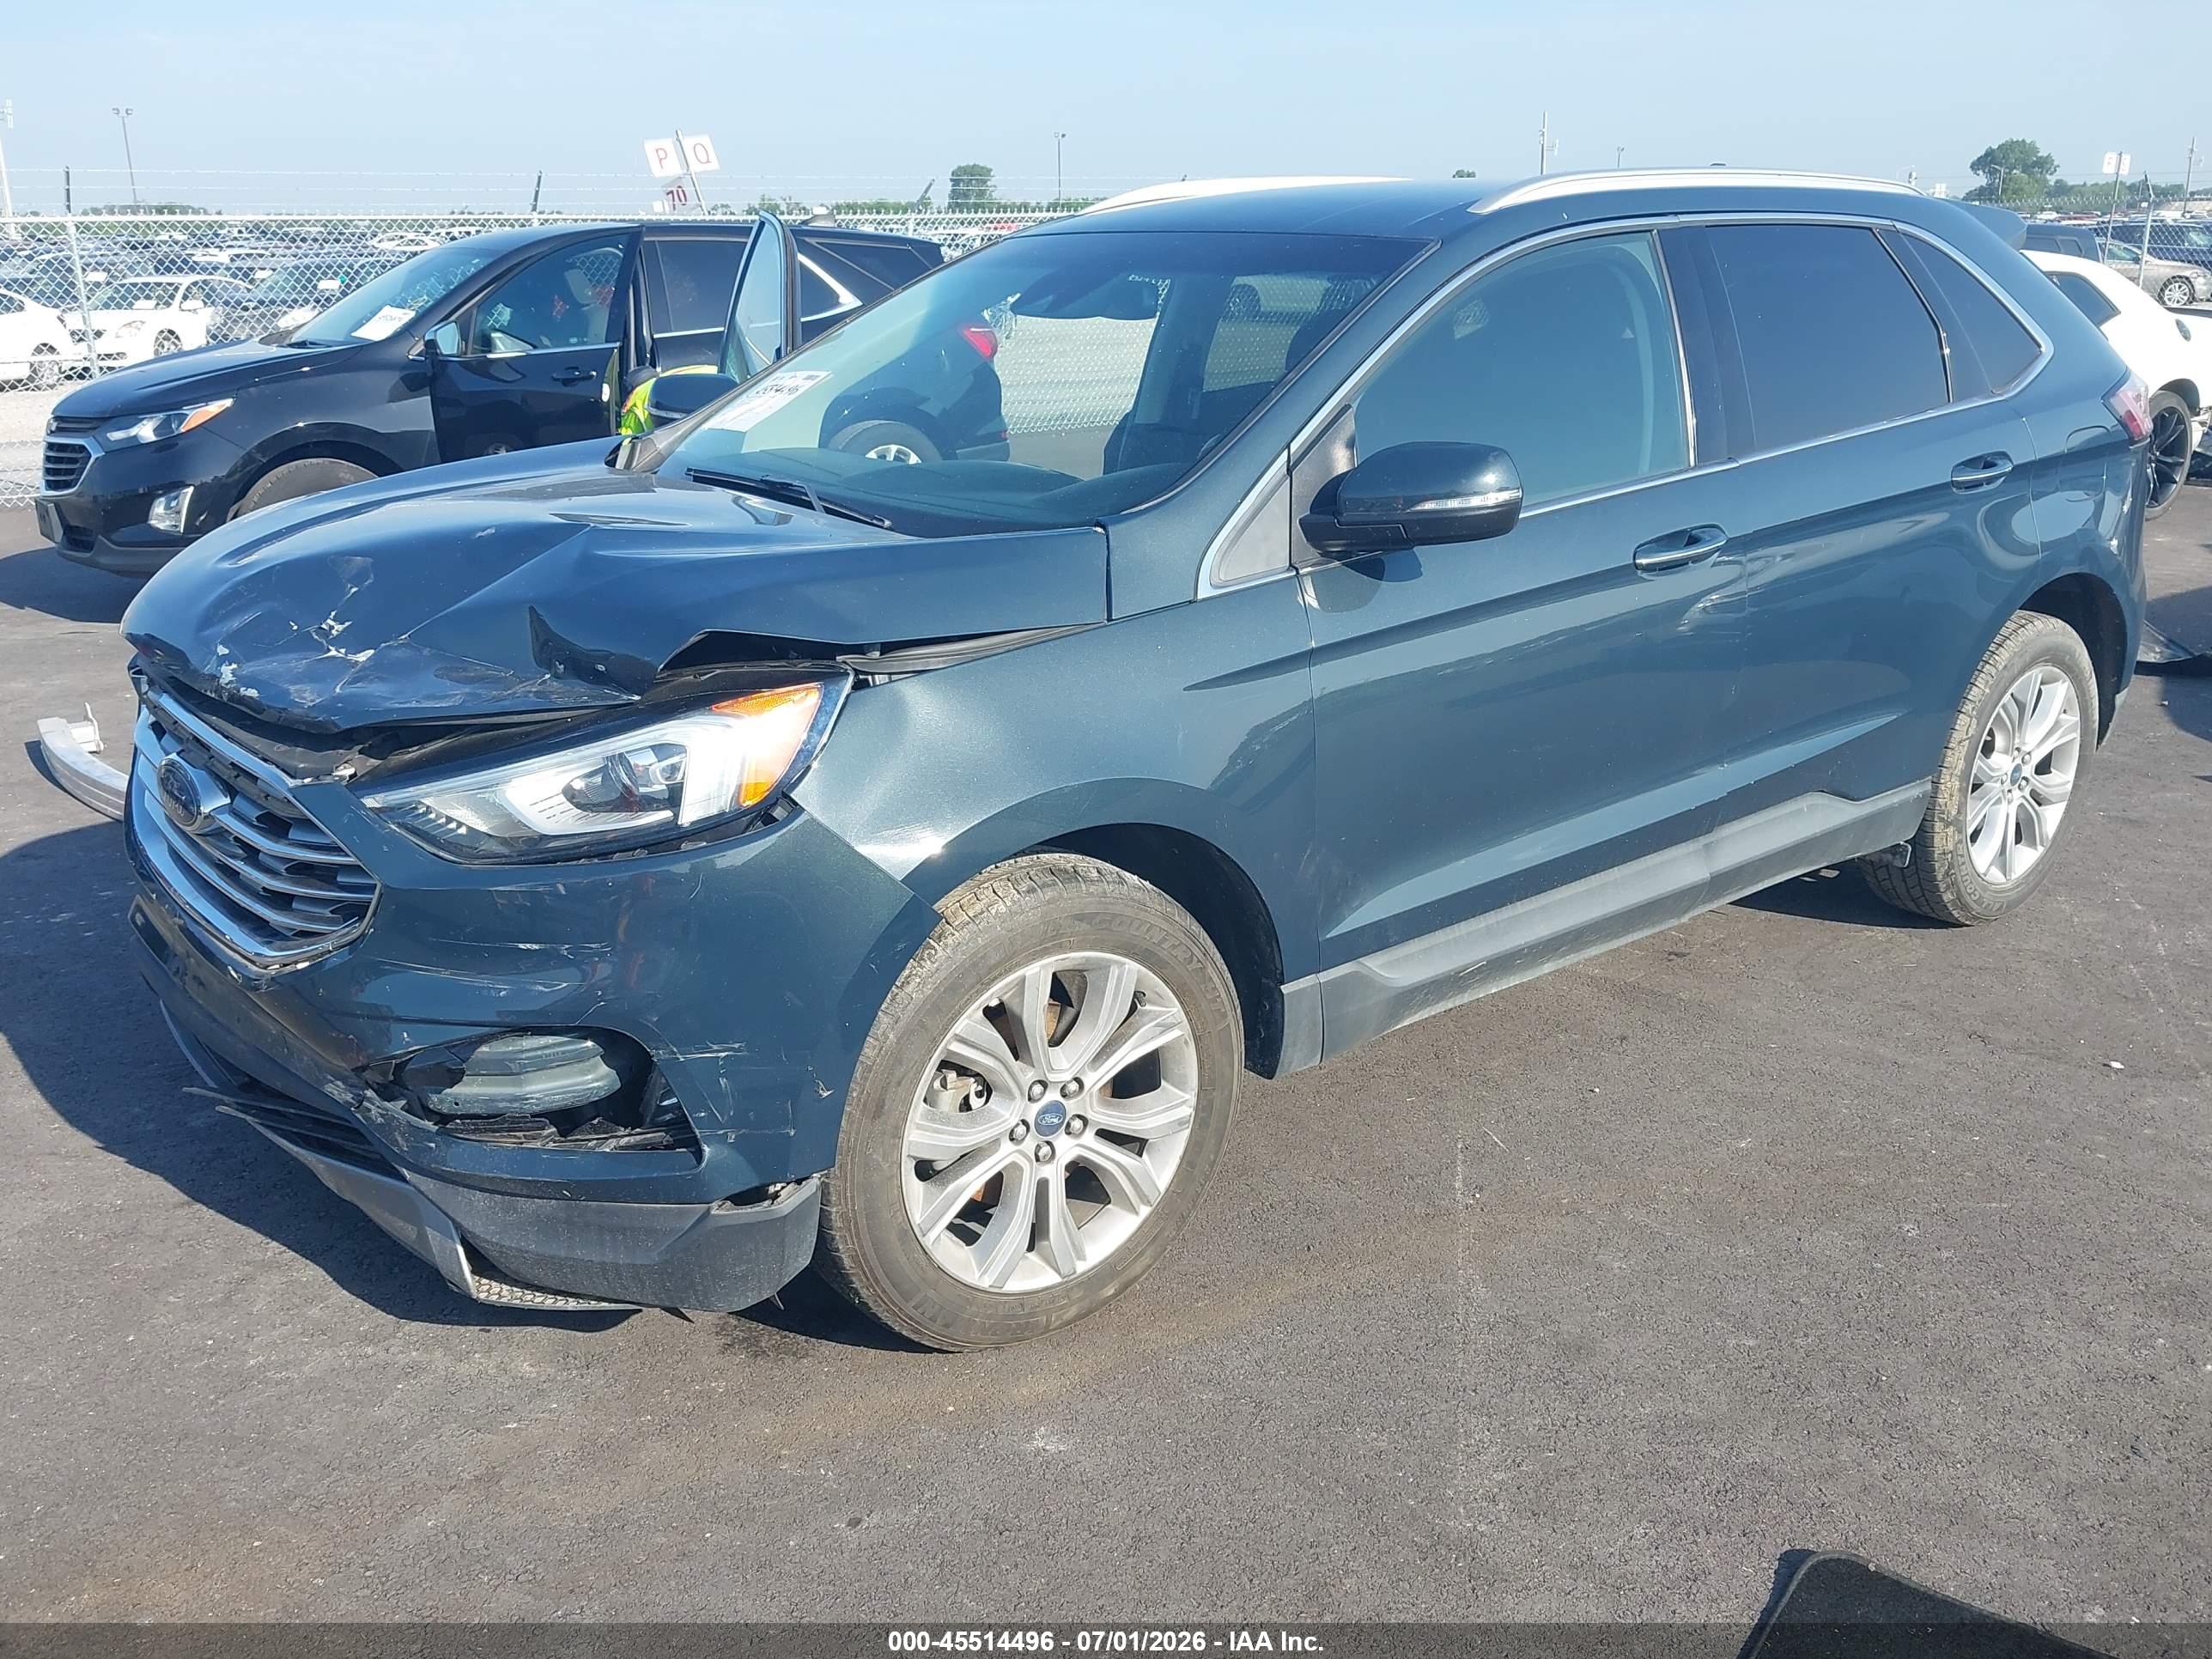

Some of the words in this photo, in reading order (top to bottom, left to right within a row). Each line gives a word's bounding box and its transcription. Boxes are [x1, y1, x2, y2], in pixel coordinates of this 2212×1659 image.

[654, 147, 668, 170] P
[693, 143, 712, 164] Q
[665, 185, 688, 211] 70
